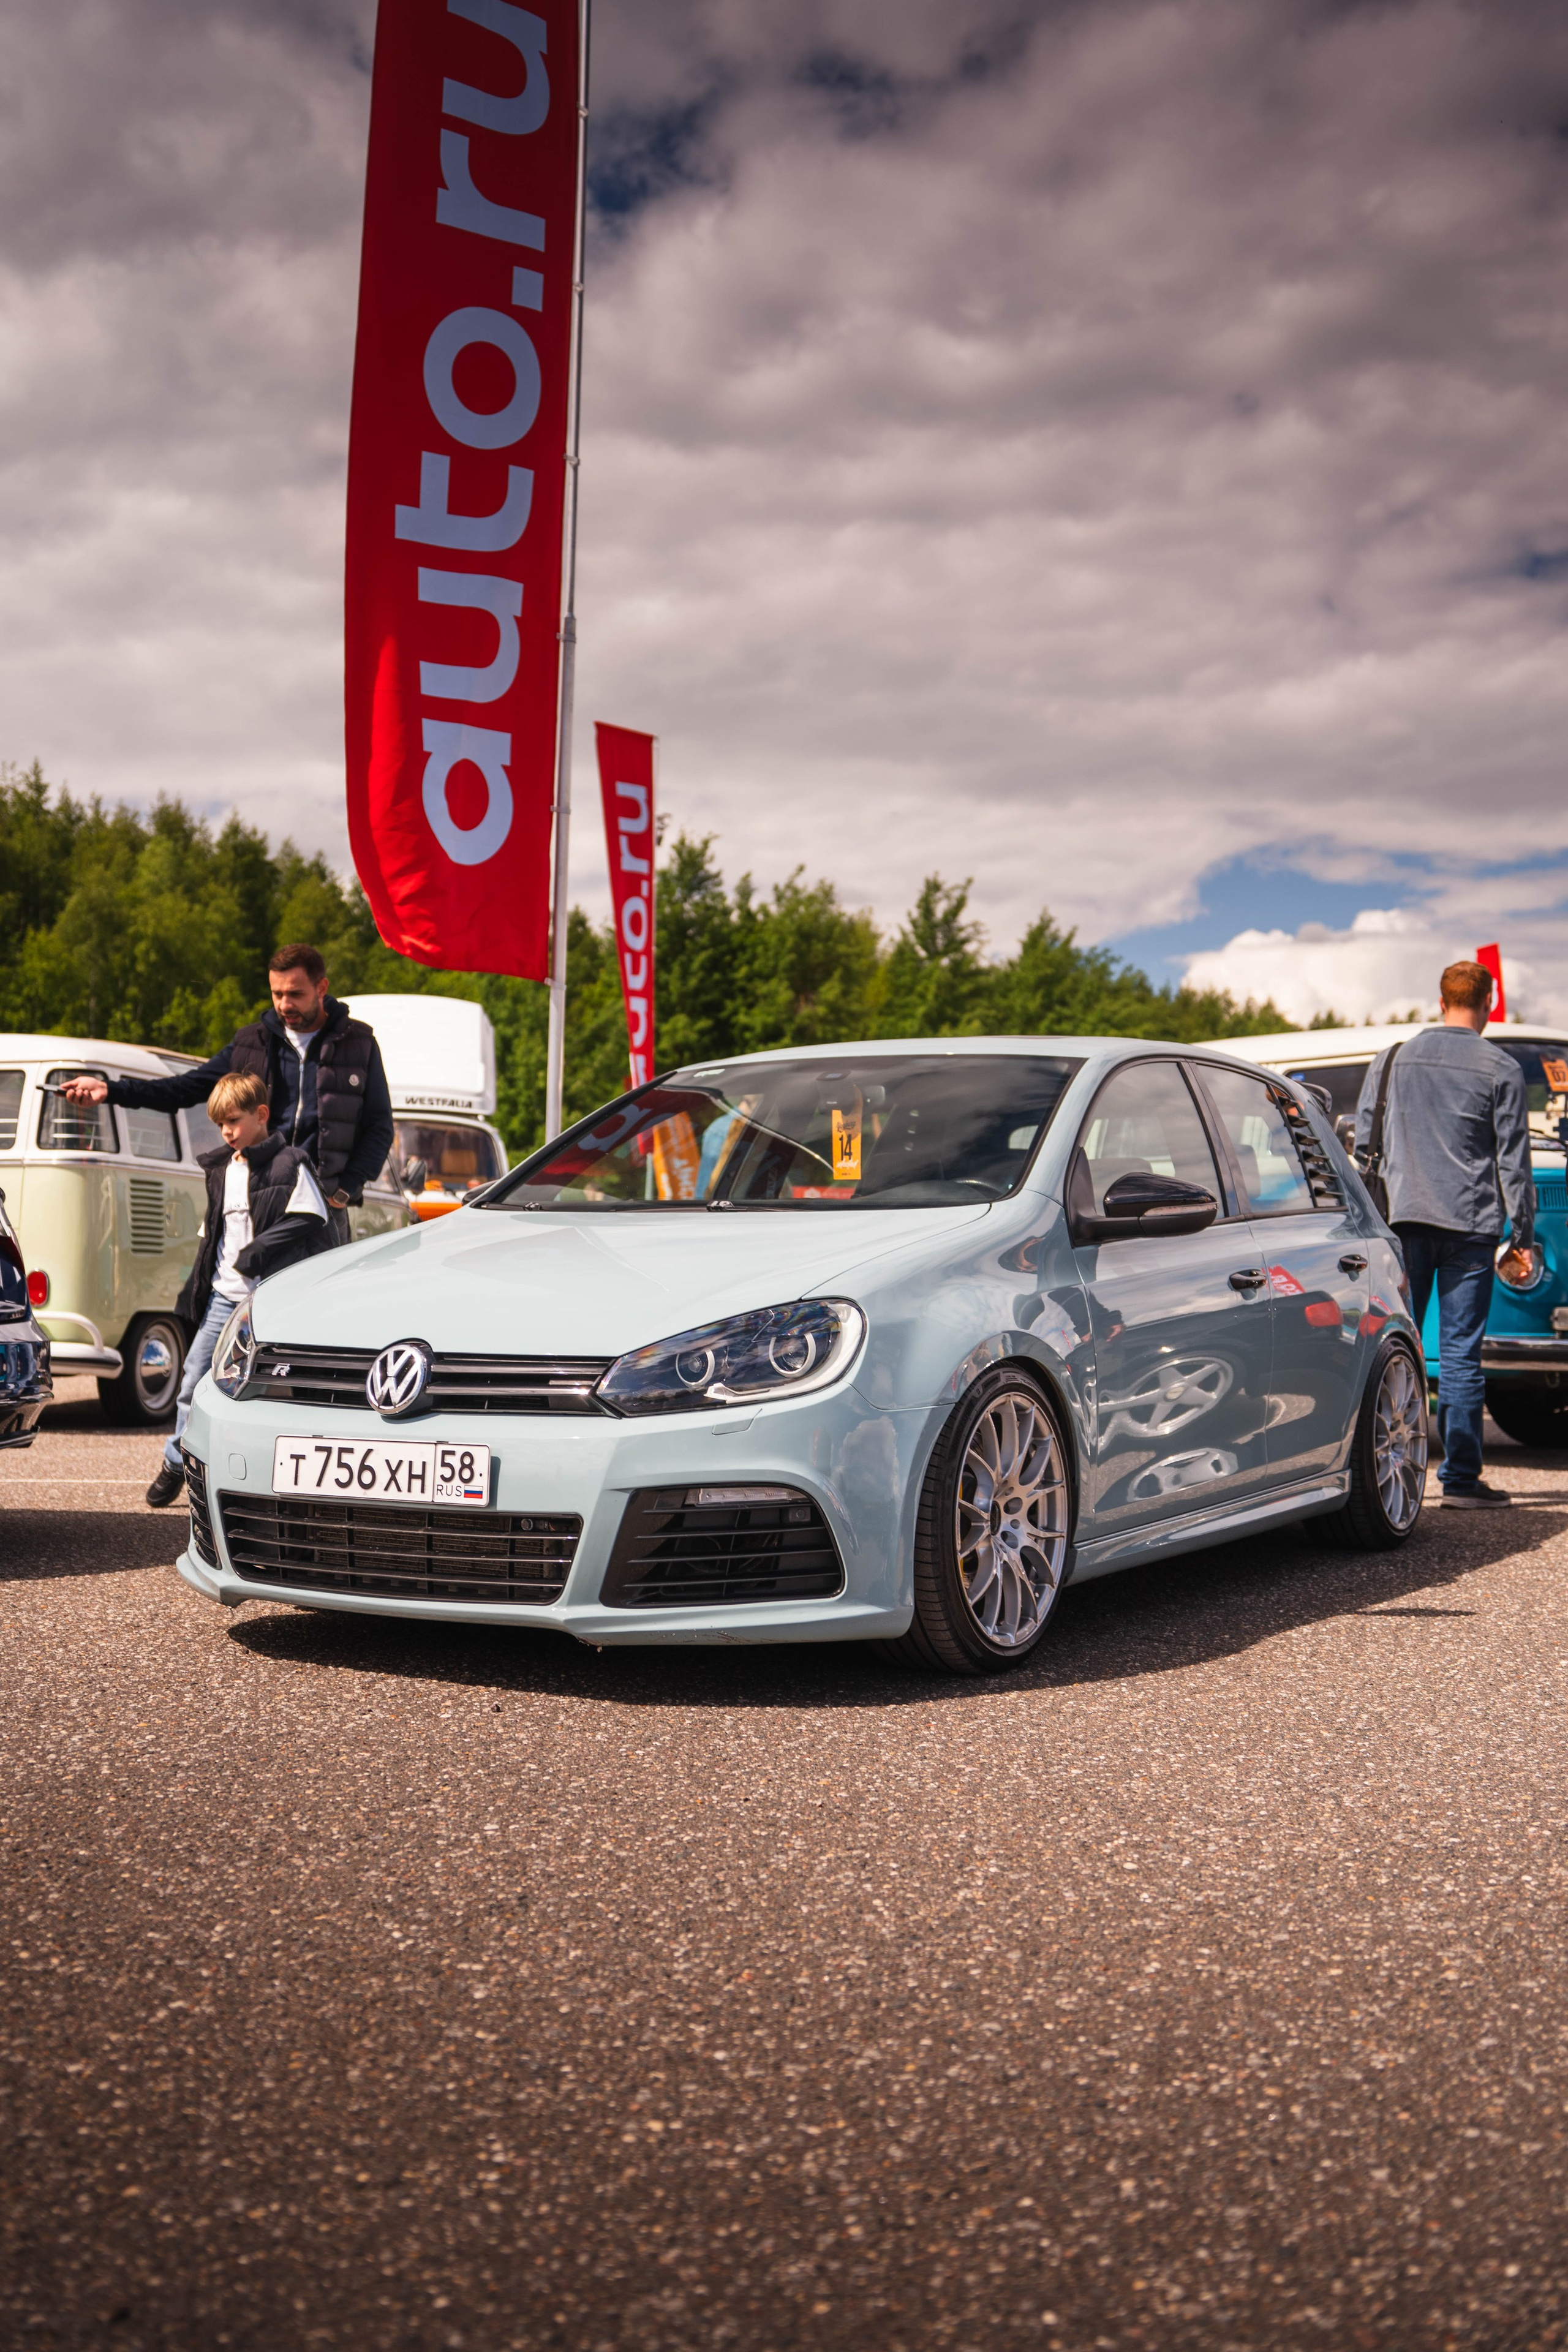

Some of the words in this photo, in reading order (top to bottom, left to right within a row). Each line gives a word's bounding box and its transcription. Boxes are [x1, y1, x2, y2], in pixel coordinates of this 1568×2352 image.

[394, 0, 550, 865] auto.ru
[405, 1096, 472, 1109] WESTFALIA
[839, 1134, 853, 1161] 14
[271, 1363, 290, 1376] R
[440, 1450, 474, 1483] 58
[436, 1484, 462, 1497] RUS
